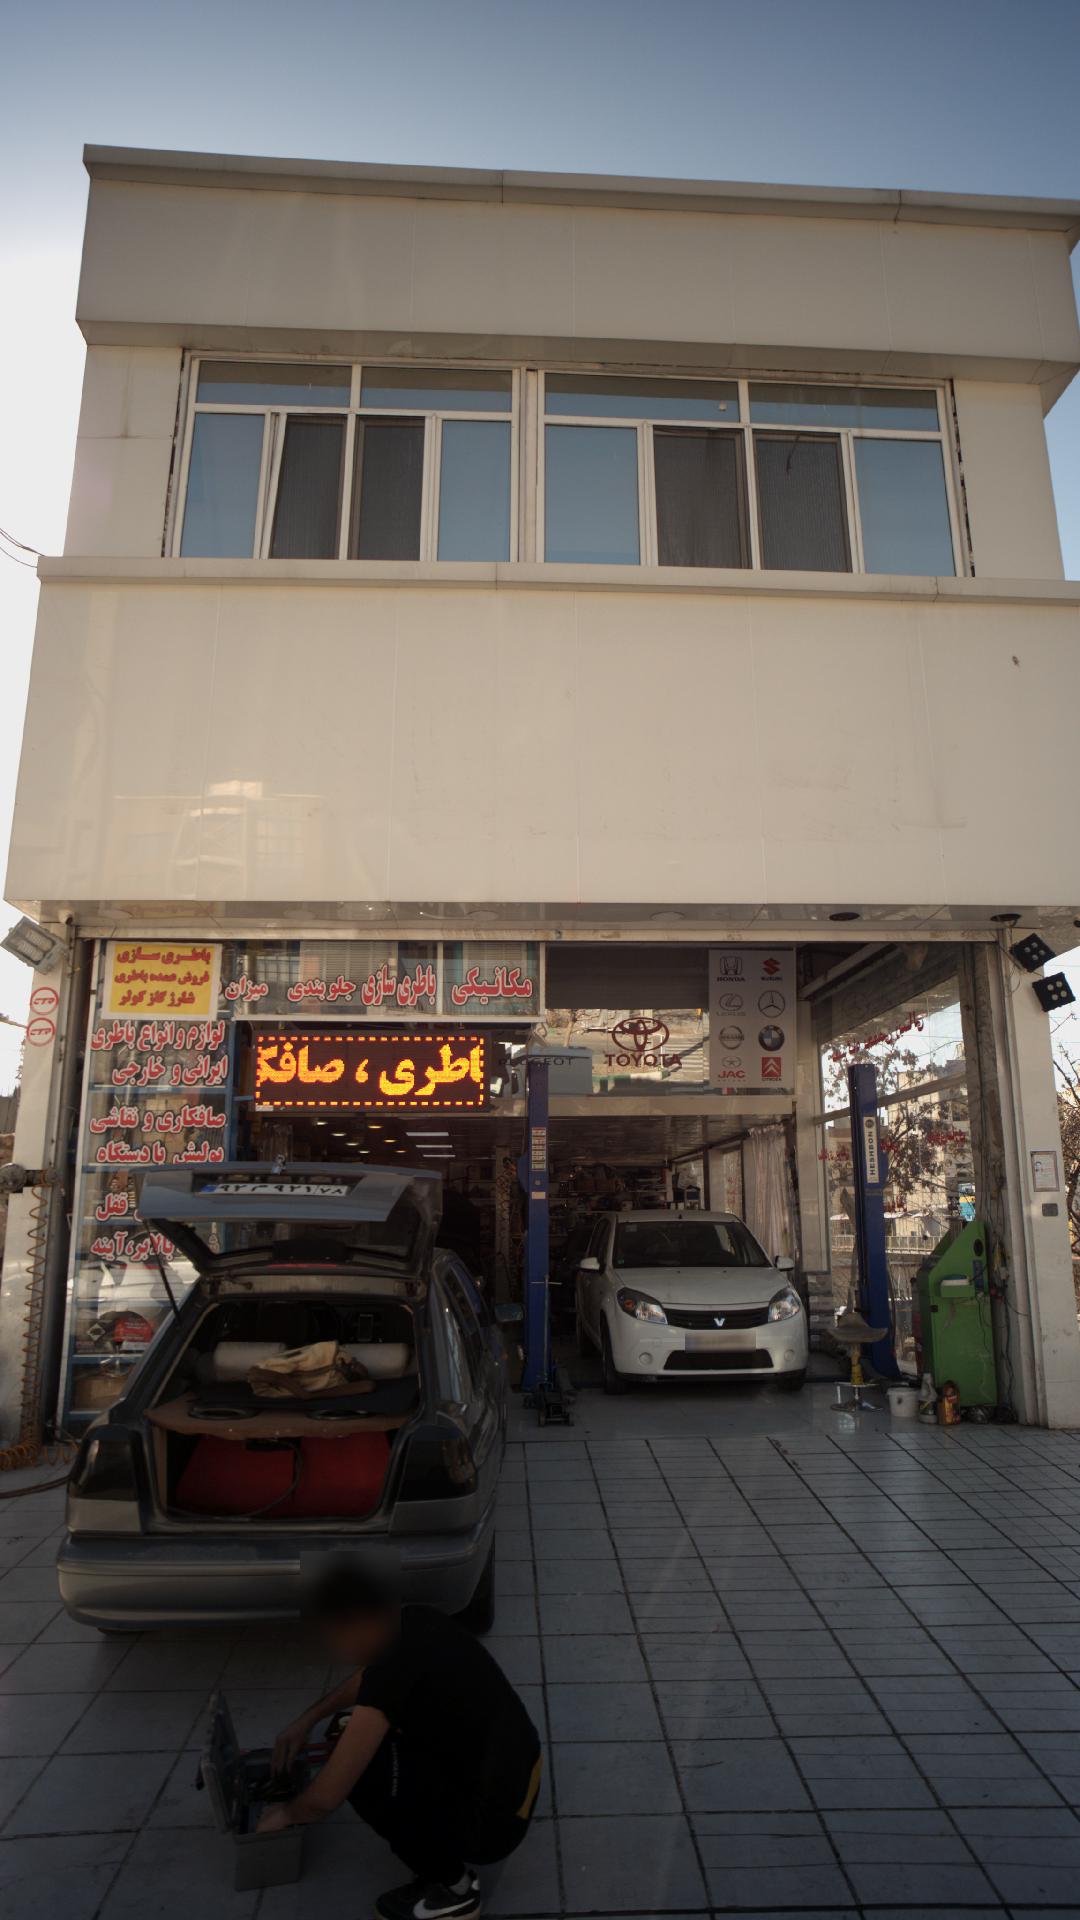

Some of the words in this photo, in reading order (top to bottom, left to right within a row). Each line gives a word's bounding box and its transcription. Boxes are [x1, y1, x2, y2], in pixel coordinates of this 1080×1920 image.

[117, 946, 161, 964] سازی
[162, 947, 211, 965] باطری
[114, 969, 149, 984] باطری
[178, 970, 210, 986] فروش
[224, 975, 269, 1002] میزان
[361, 964, 396, 1006] سازی
[396, 964, 438, 1006] باطری
[451, 966, 533, 1006] مکانیکی
[90, 1019, 136, 1051] باطری
[136, 1020, 175, 1051] انواع
[173, 1027, 185, 1051] و
[186, 1019, 226, 1051] لوازم
[112, 1054, 166, 1086] خارجی
[169, 1063, 182, 1085] و
[182, 1054, 229, 1086] ایرانی
[606, 1054, 682, 1067] TOYOTA
[718, 1070, 746, 1079] JAC
[89, 1105, 139, 1133] نقاشی
[141, 1111, 154, 1132] و
[156, 1104, 227, 1133] صافکاری
[96, 1140, 151, 1163] دستگاه
[866, 1131, 876, 1176] HESHBON
[96, 1192, 129, 1222] قفل
[90, 1231, 128, 1261] آینه
